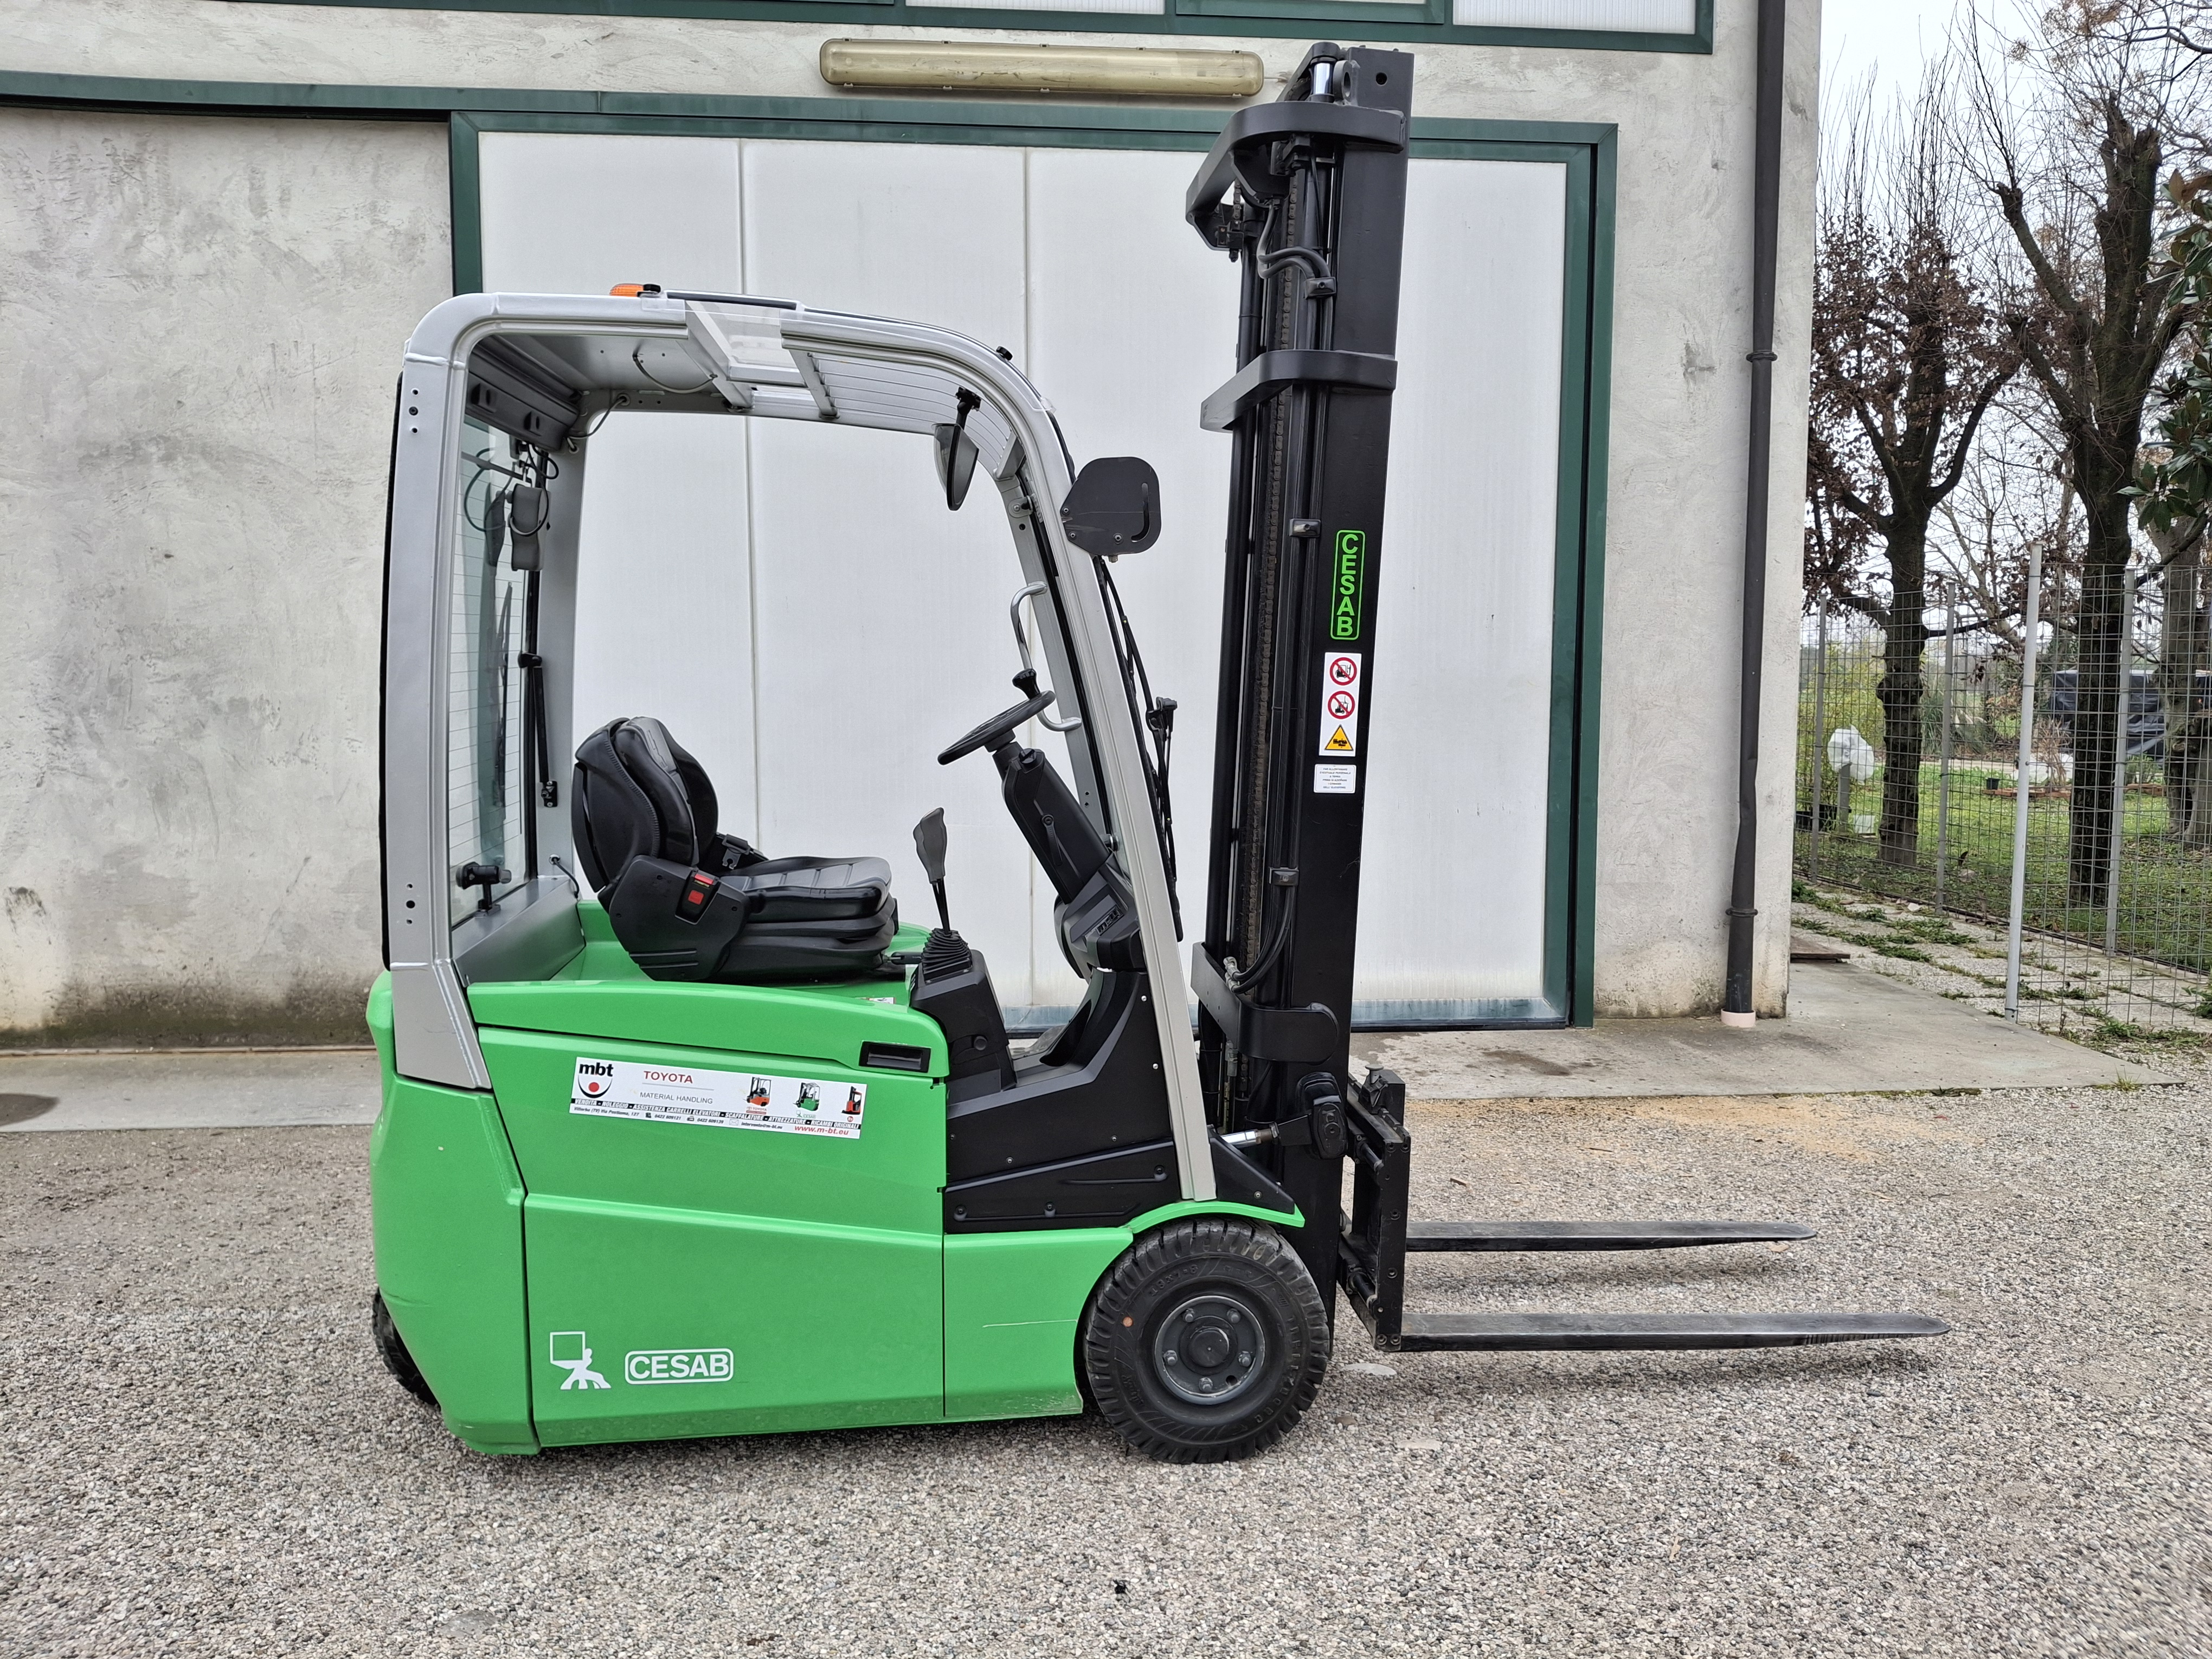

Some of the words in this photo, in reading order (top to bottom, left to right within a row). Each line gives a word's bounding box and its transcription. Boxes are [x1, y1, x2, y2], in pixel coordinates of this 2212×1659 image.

[1336, 533, 1359, 636] CESAB
[579, 1062, 614, 1077] mbt
[644, 1071, 693, 1084] TOYOTA
[640, 1092, 674, 1101] MATERIAL
[676, 1095, 713, 1104] HANDLING
[602, 1101, 629, 1109] NOLEGGIO
[632, 1104, 665, 1112] ASSISTENZA
[725, 1112, 764, 1121] SCAFFALATURE
[768, 1116, 806, 1125] ATTREZZATURE
[795, 1125, 849, 1135] www.m-bt.eu
[629, 1354, 729, 1379] CESAB
